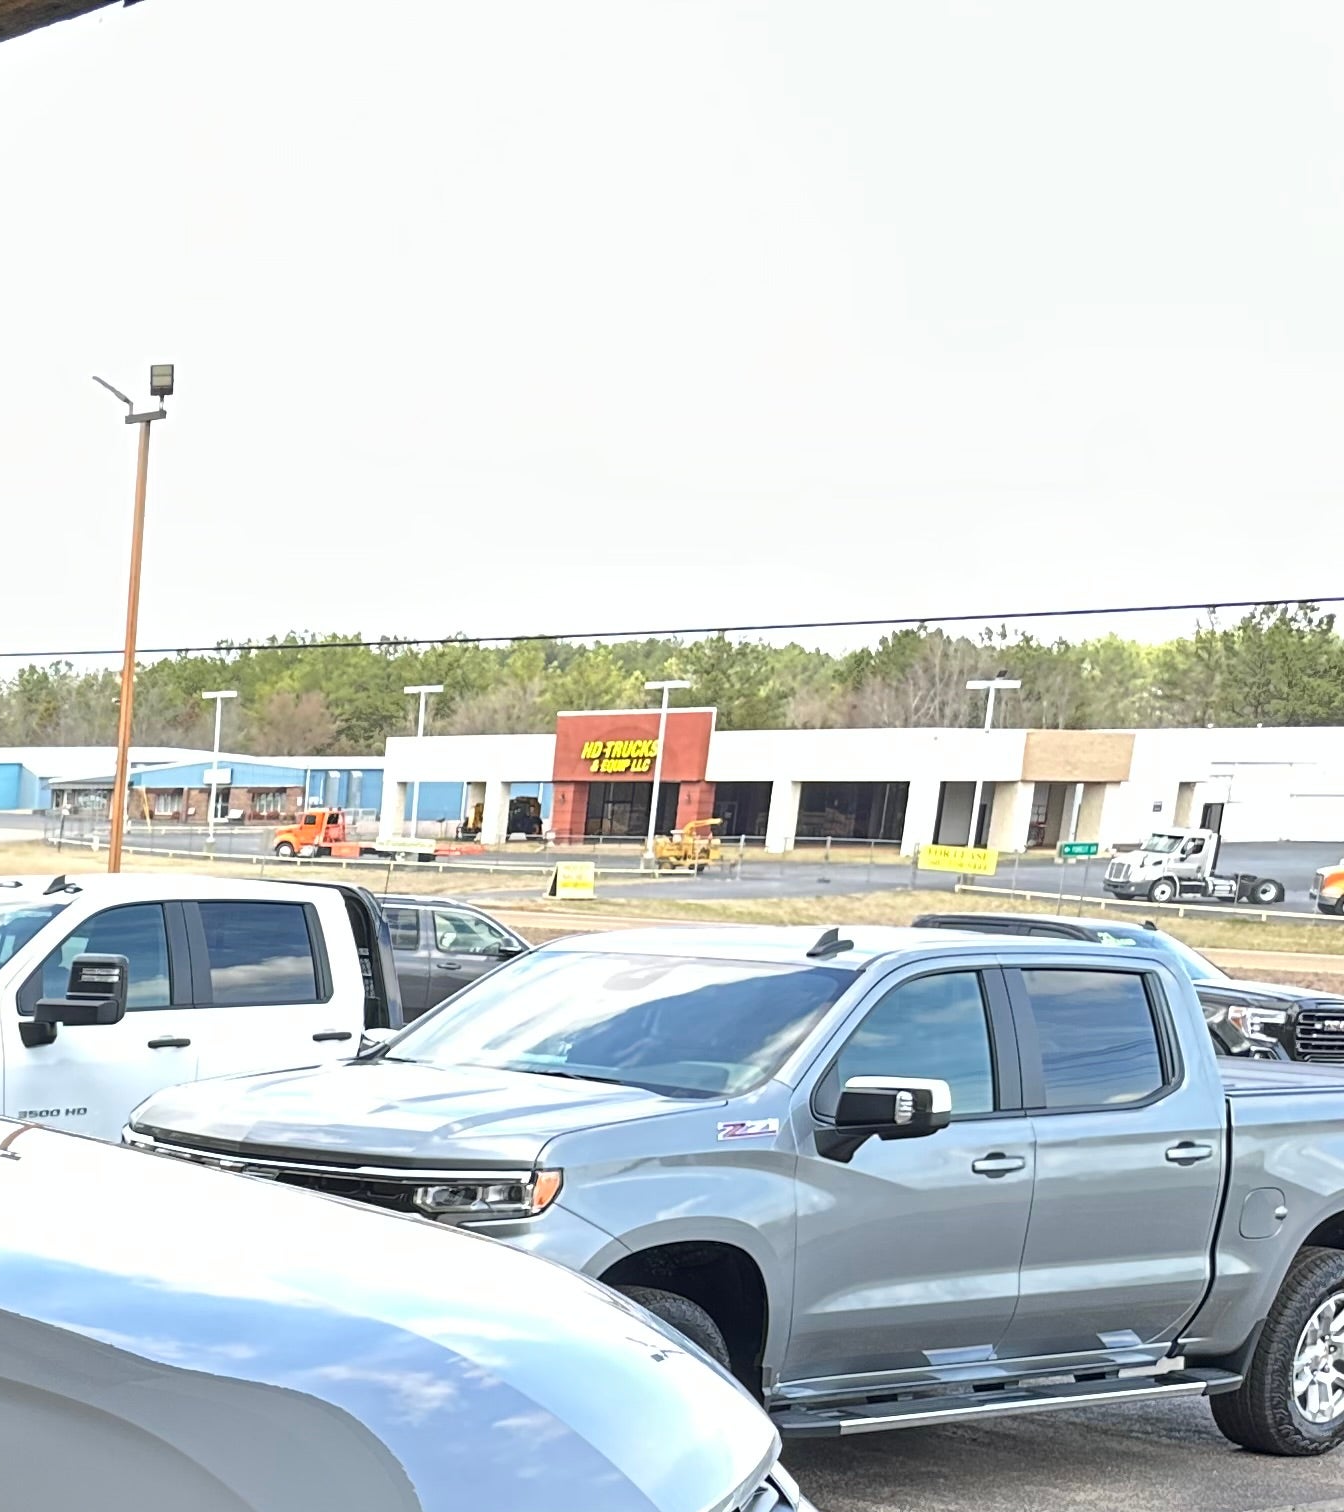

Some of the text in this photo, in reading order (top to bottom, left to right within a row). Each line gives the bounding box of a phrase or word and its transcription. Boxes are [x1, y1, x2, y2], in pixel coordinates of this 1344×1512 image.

[600, 758, 631, 773] EQUIP
[630, 758, 651, 772] LLC
[18, 1107, 88, 1119] 3500 HD
